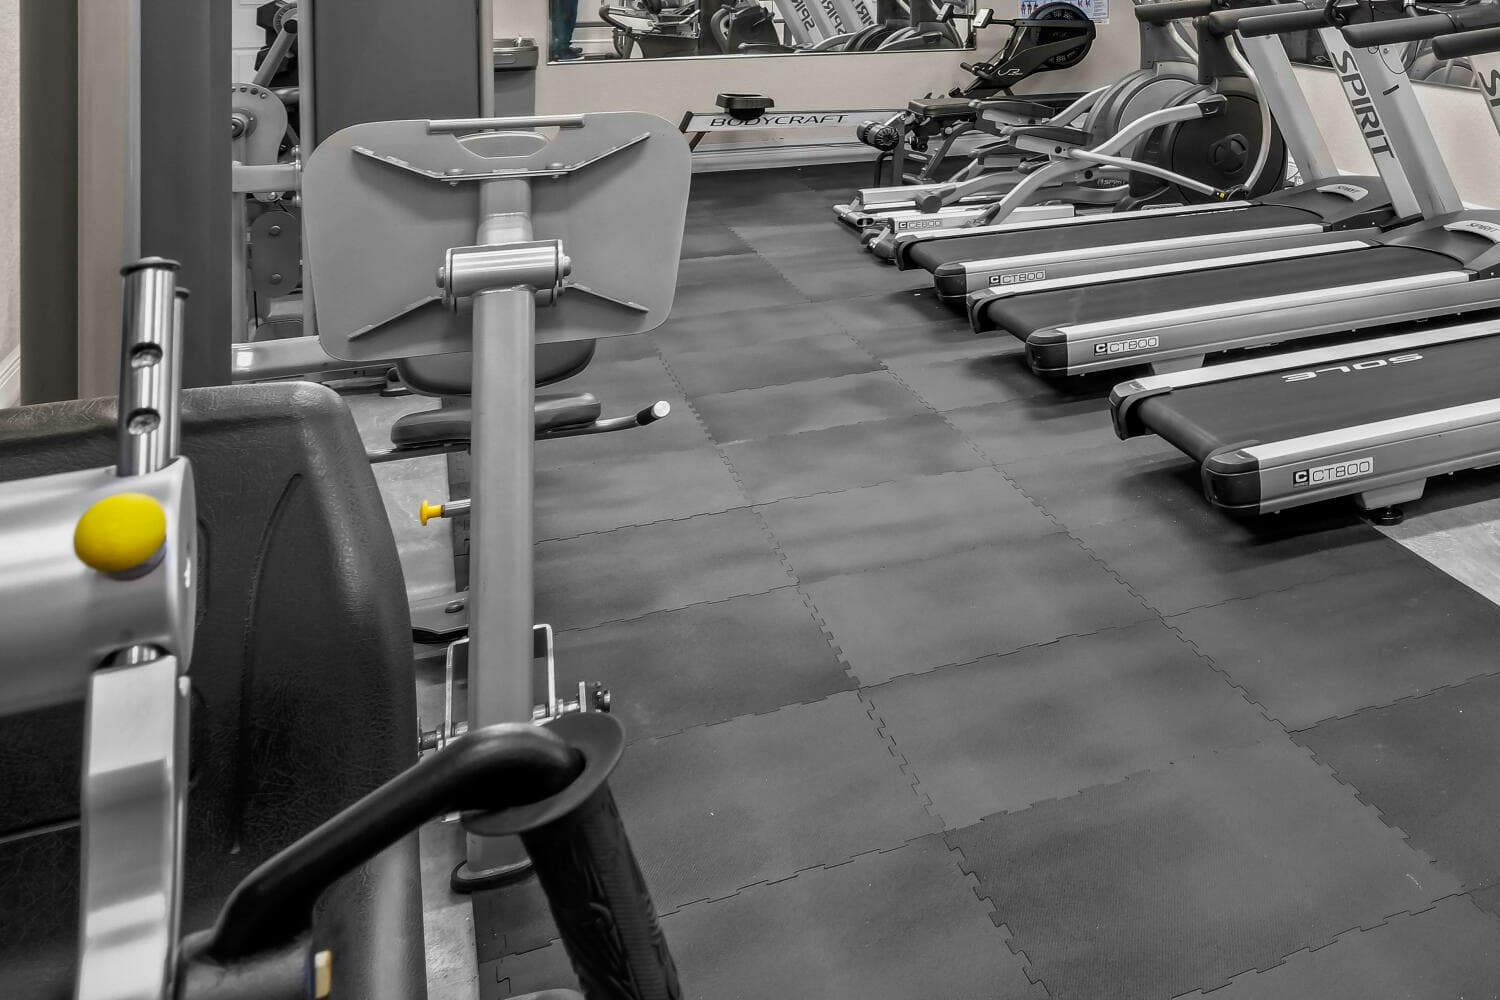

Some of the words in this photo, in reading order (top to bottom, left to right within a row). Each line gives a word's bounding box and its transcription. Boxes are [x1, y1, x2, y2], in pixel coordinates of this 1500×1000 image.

[1331, 50, 1395, 159] SPIRIT
[1002, 271, 1044, 284] CT800
[1109, 337, 1157, 353] CT800
[1281, 353, 1424, 383] SOLE
[1313, 460, 1370, 482] CT800
